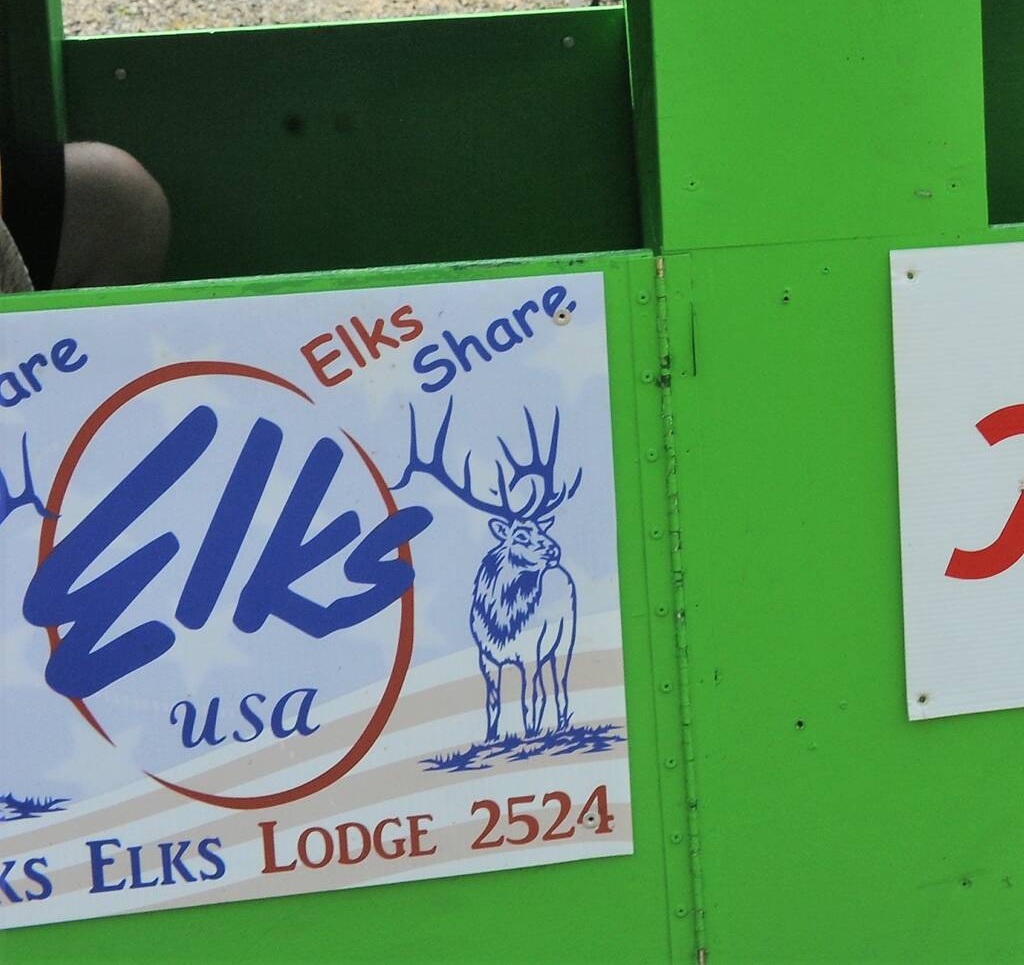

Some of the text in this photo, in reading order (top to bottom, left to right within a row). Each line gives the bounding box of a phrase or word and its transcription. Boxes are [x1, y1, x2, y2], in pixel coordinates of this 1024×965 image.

[0, 338, 88, 408] are
[303, 305, 424, 388] Elks
[413, 284, 577, 393] Share
[23, 405, 434, 700] Elks
[169, 688, 320, 748] usa
[86, 838, 226, 894] ELKS
[259, 815, 437, 874] LODGE
[471, 784, 615, 851] 2524
